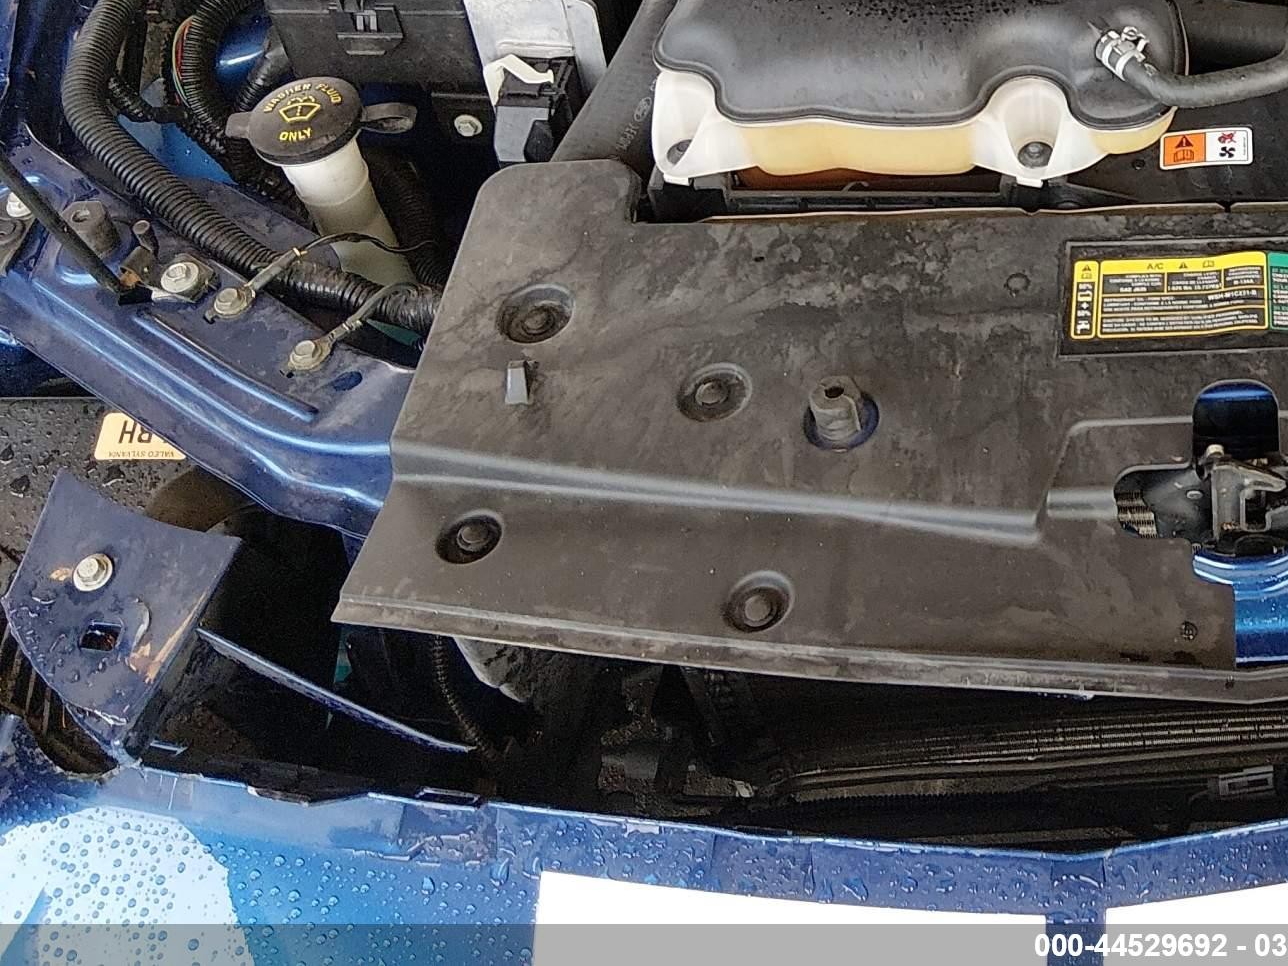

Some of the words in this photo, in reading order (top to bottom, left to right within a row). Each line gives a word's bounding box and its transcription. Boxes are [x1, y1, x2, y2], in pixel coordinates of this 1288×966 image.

[315, 83, 342, 104] FLUID
[279, 127, 313, 142] ONLY
[1146, 262, 1164, 271] A/C
[117, 420, 153, 444] RH
